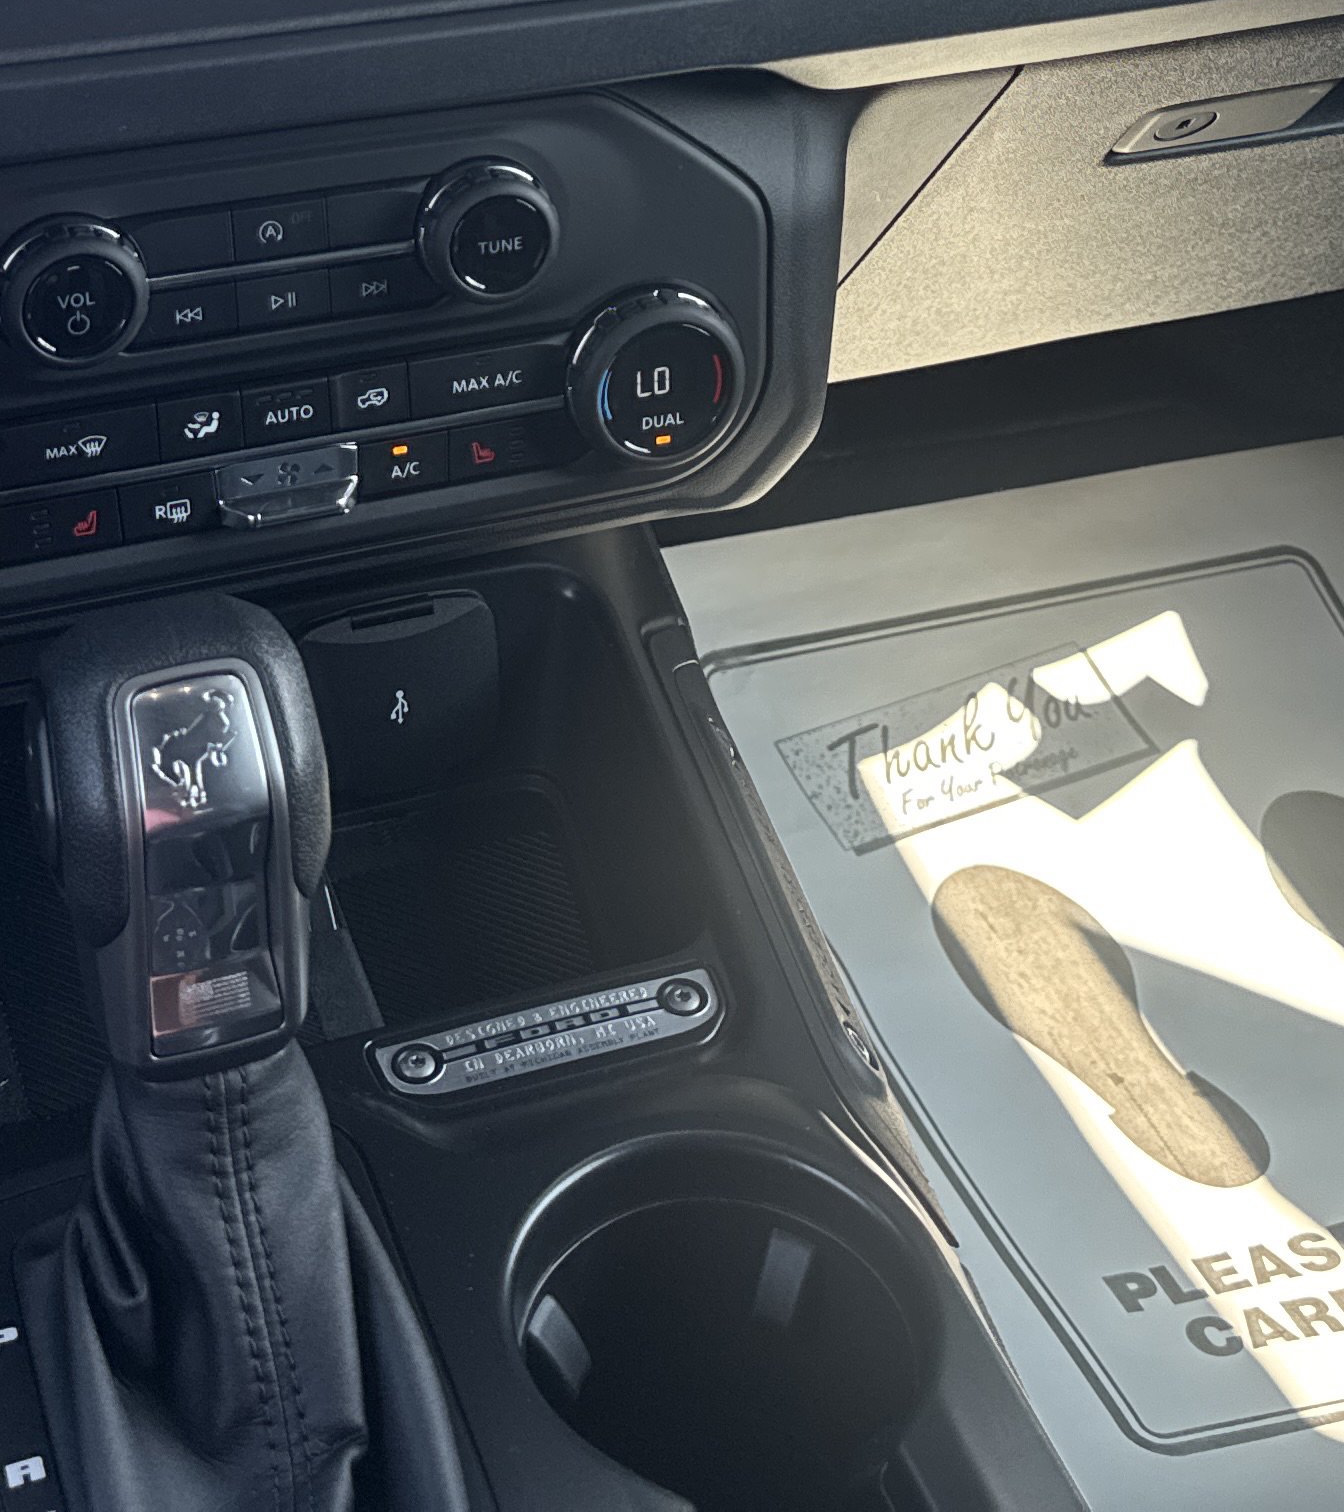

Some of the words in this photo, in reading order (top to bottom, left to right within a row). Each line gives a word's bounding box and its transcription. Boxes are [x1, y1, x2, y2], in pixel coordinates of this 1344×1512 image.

[477, 235, 523, 254] TUNE
[57, 291, 96, 310] VOL
[453, 375, 490, 394] MAX
[494, 370, 523, 388] A/C
[636, 367, 669, 398] LO
[265, 405, 314, 426] AUTO
[642, 413, 684, 431] DUAL
[46, 444, 78, 460] MAX
[391, 461, 421, 480] A/C
[827, 692, 995, 801] Thank
[1006, 676, 1093, 742] You
[902, 789, 935, 816] For
[940, 776, 983, 801] Your
[445, 1016, 525, 1046] DESIGNED
[550, 986, 648, 1016] ENGINEERED
[484, 1008, 621, 1049] FORD
[464, 1057, 485, 1072] IN
[494, 1035, 585, 1065] DEARBORN,
[595, 1023, 617, 1038] MI
[624, 1015, 656, 1031] USA
[5, 1456, 46, 1488] R
